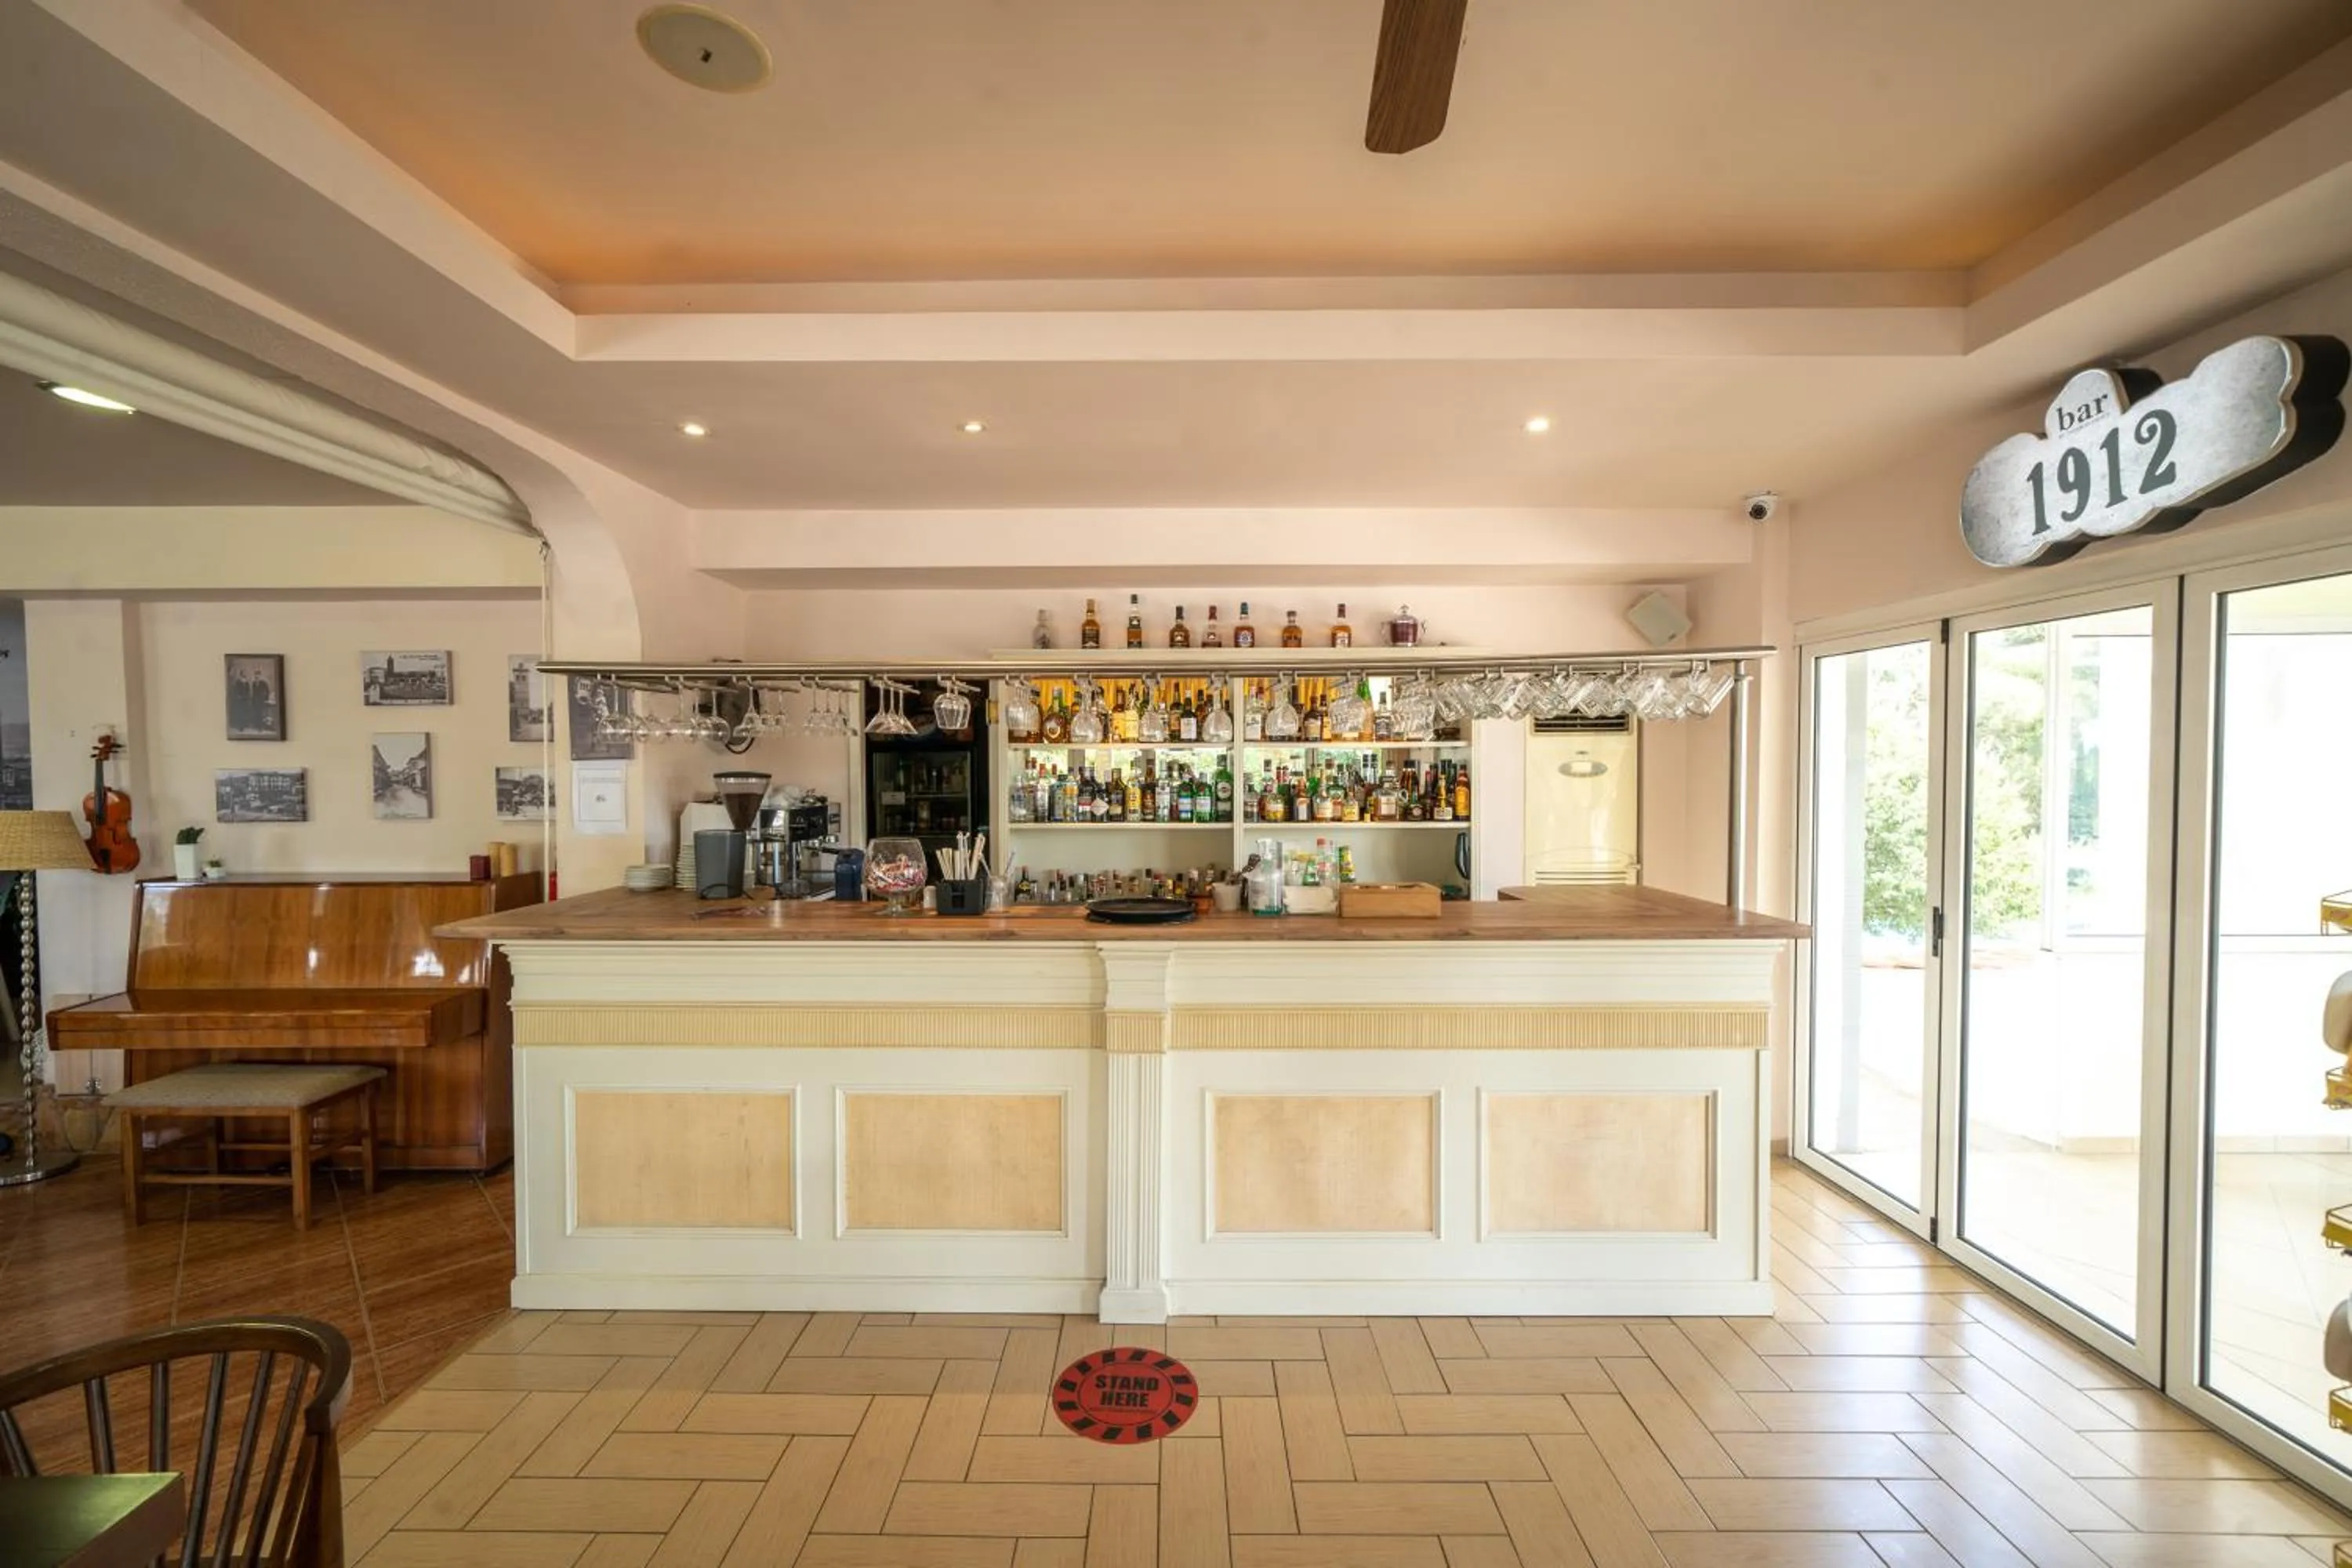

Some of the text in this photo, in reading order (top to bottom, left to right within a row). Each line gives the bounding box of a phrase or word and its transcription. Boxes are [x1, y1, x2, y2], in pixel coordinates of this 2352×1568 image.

[2056, 394, 2107, 431] bar
[2027, 409, 2176, 535] 1912
[1095, 1375, 1159, 1390] STAND
[1100, 1392, 1149, 1406] HERE
